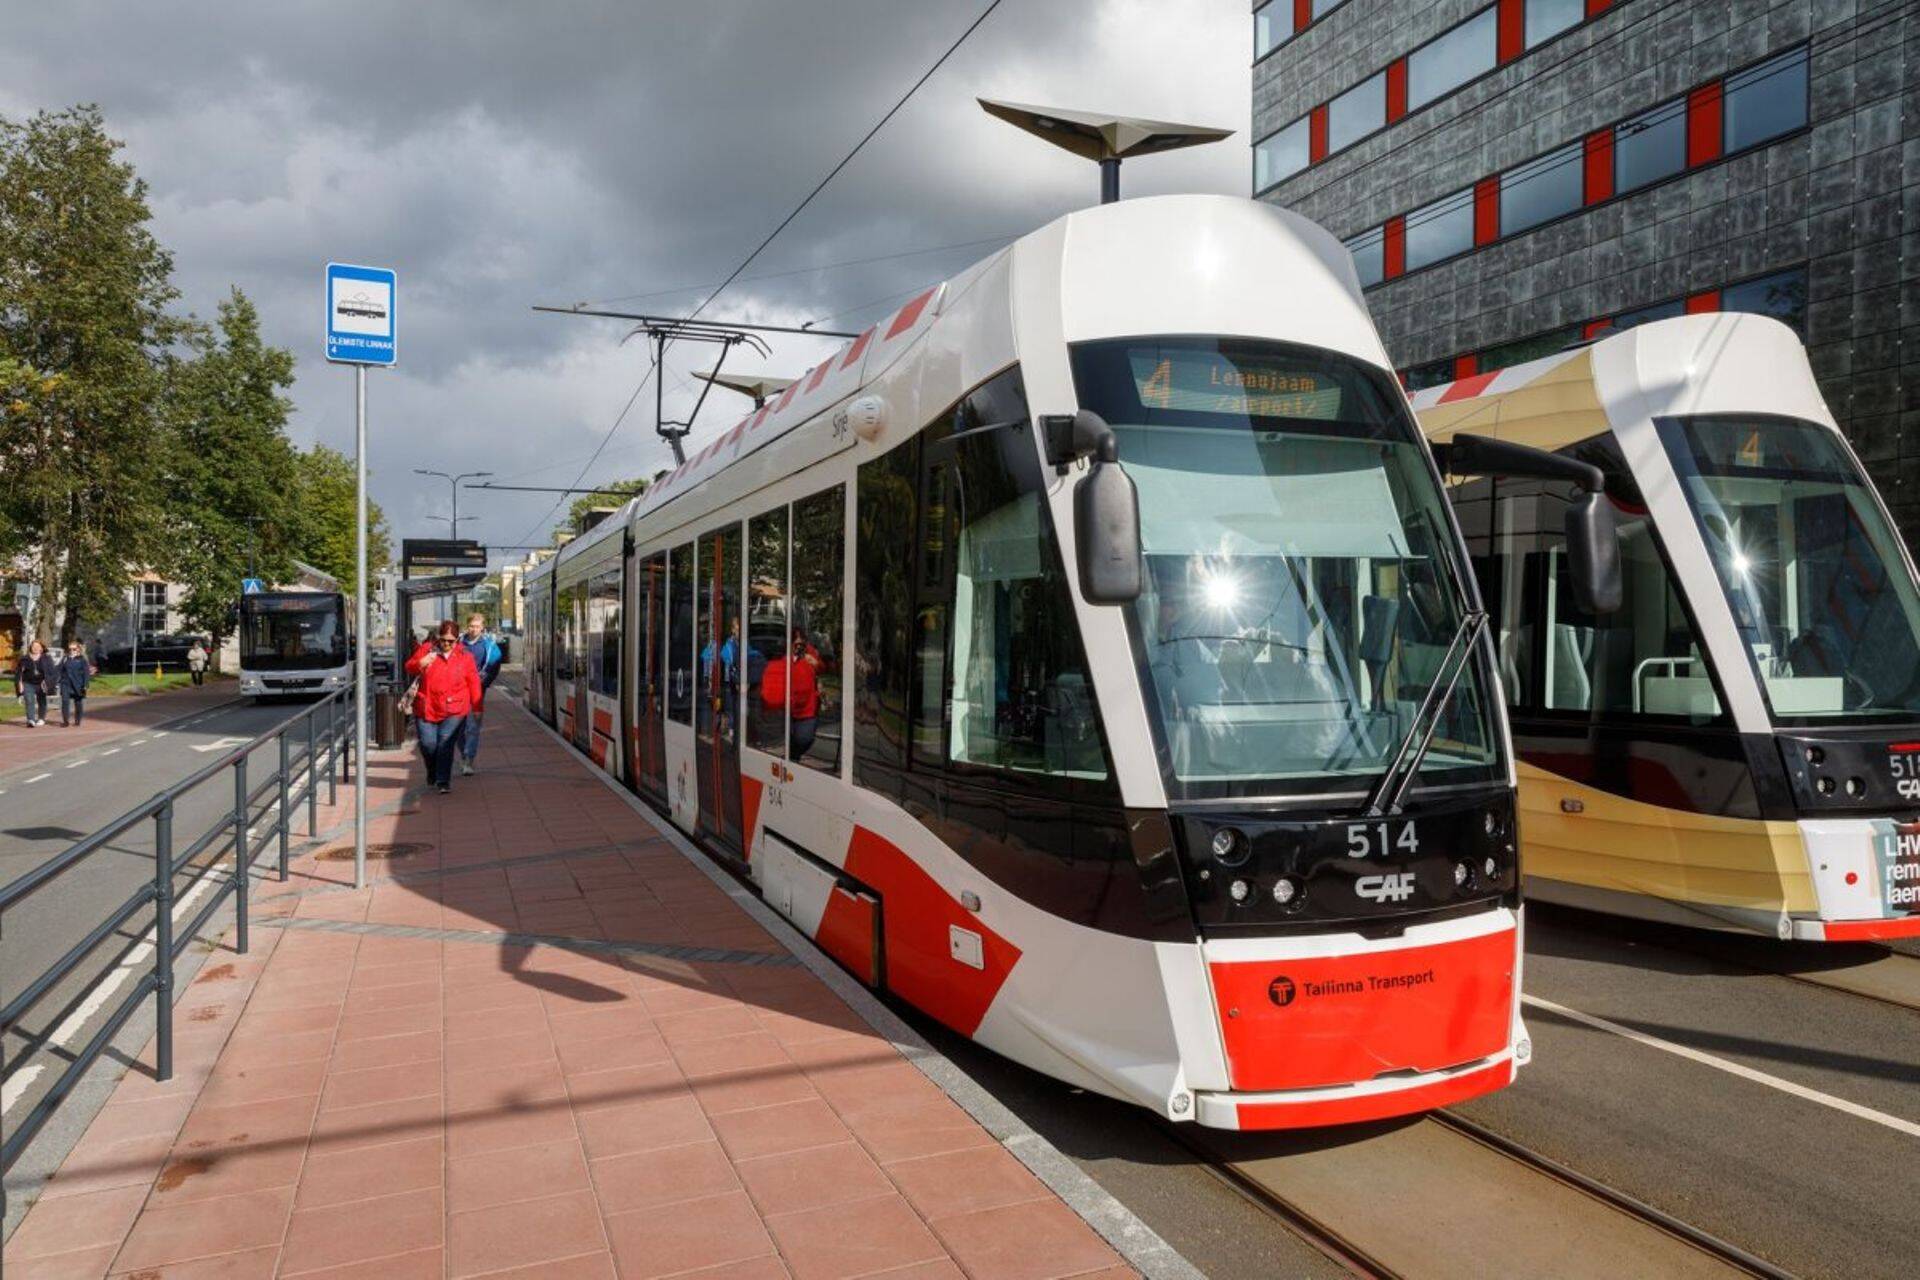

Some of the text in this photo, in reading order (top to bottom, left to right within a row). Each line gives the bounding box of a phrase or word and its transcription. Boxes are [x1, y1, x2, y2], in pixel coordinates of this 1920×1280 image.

[1142, 358, 1171, 409] 4
[1740, 431, 1759, 466] 4
[1889, 754, 1920, 778] 51
[1348, 821, 1419, 858] 514
[1355, 873, 1415, 902] CAF
[1304, 969, 1434, 997] Tallinna Transport
